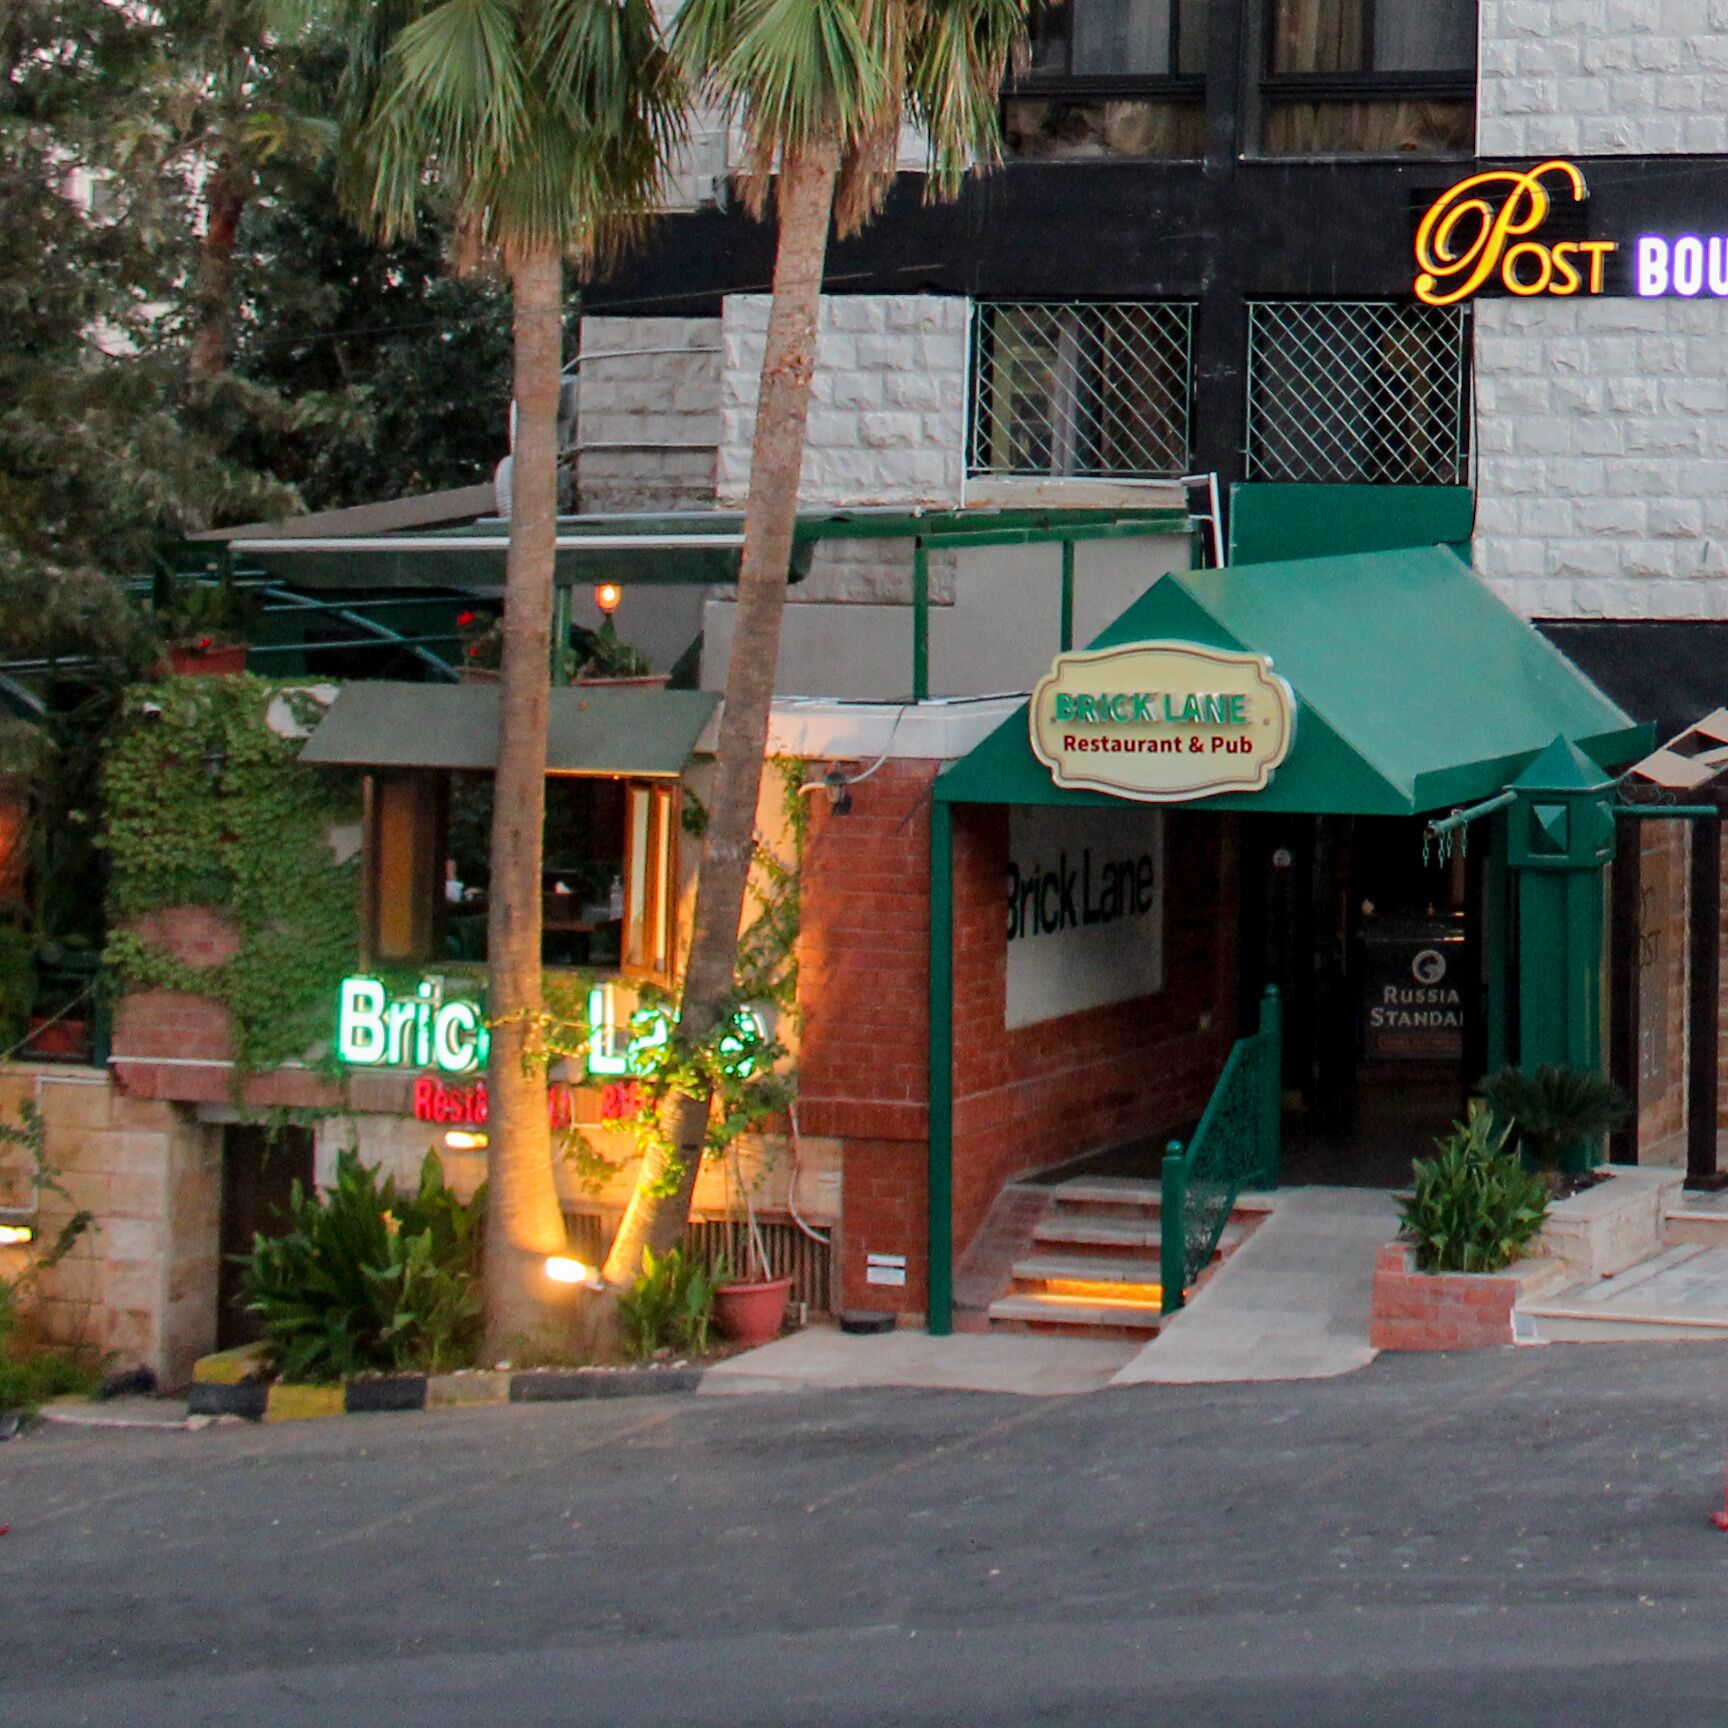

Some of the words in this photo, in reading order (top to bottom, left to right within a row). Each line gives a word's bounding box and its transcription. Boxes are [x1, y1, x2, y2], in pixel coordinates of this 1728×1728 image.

[1413, 159, 1619, 306] POST
[1055, 692, 1156, 723] BRICK
[1163, 692, 1249, 723] LANE
[1063, 734, 1182, 753] Restaurant
[1188, 735, 1204, 753] &
[1211, 735, 1253, 754] Pub
[1006, 851, 1078, 941] Brick
[1082, 846, 1154, 925] Lane
[340, 977, 491, 1072] Bric
[588, 987, 758, 1078] Lae
[1369, 1006, 1464, 1027] STANDA
